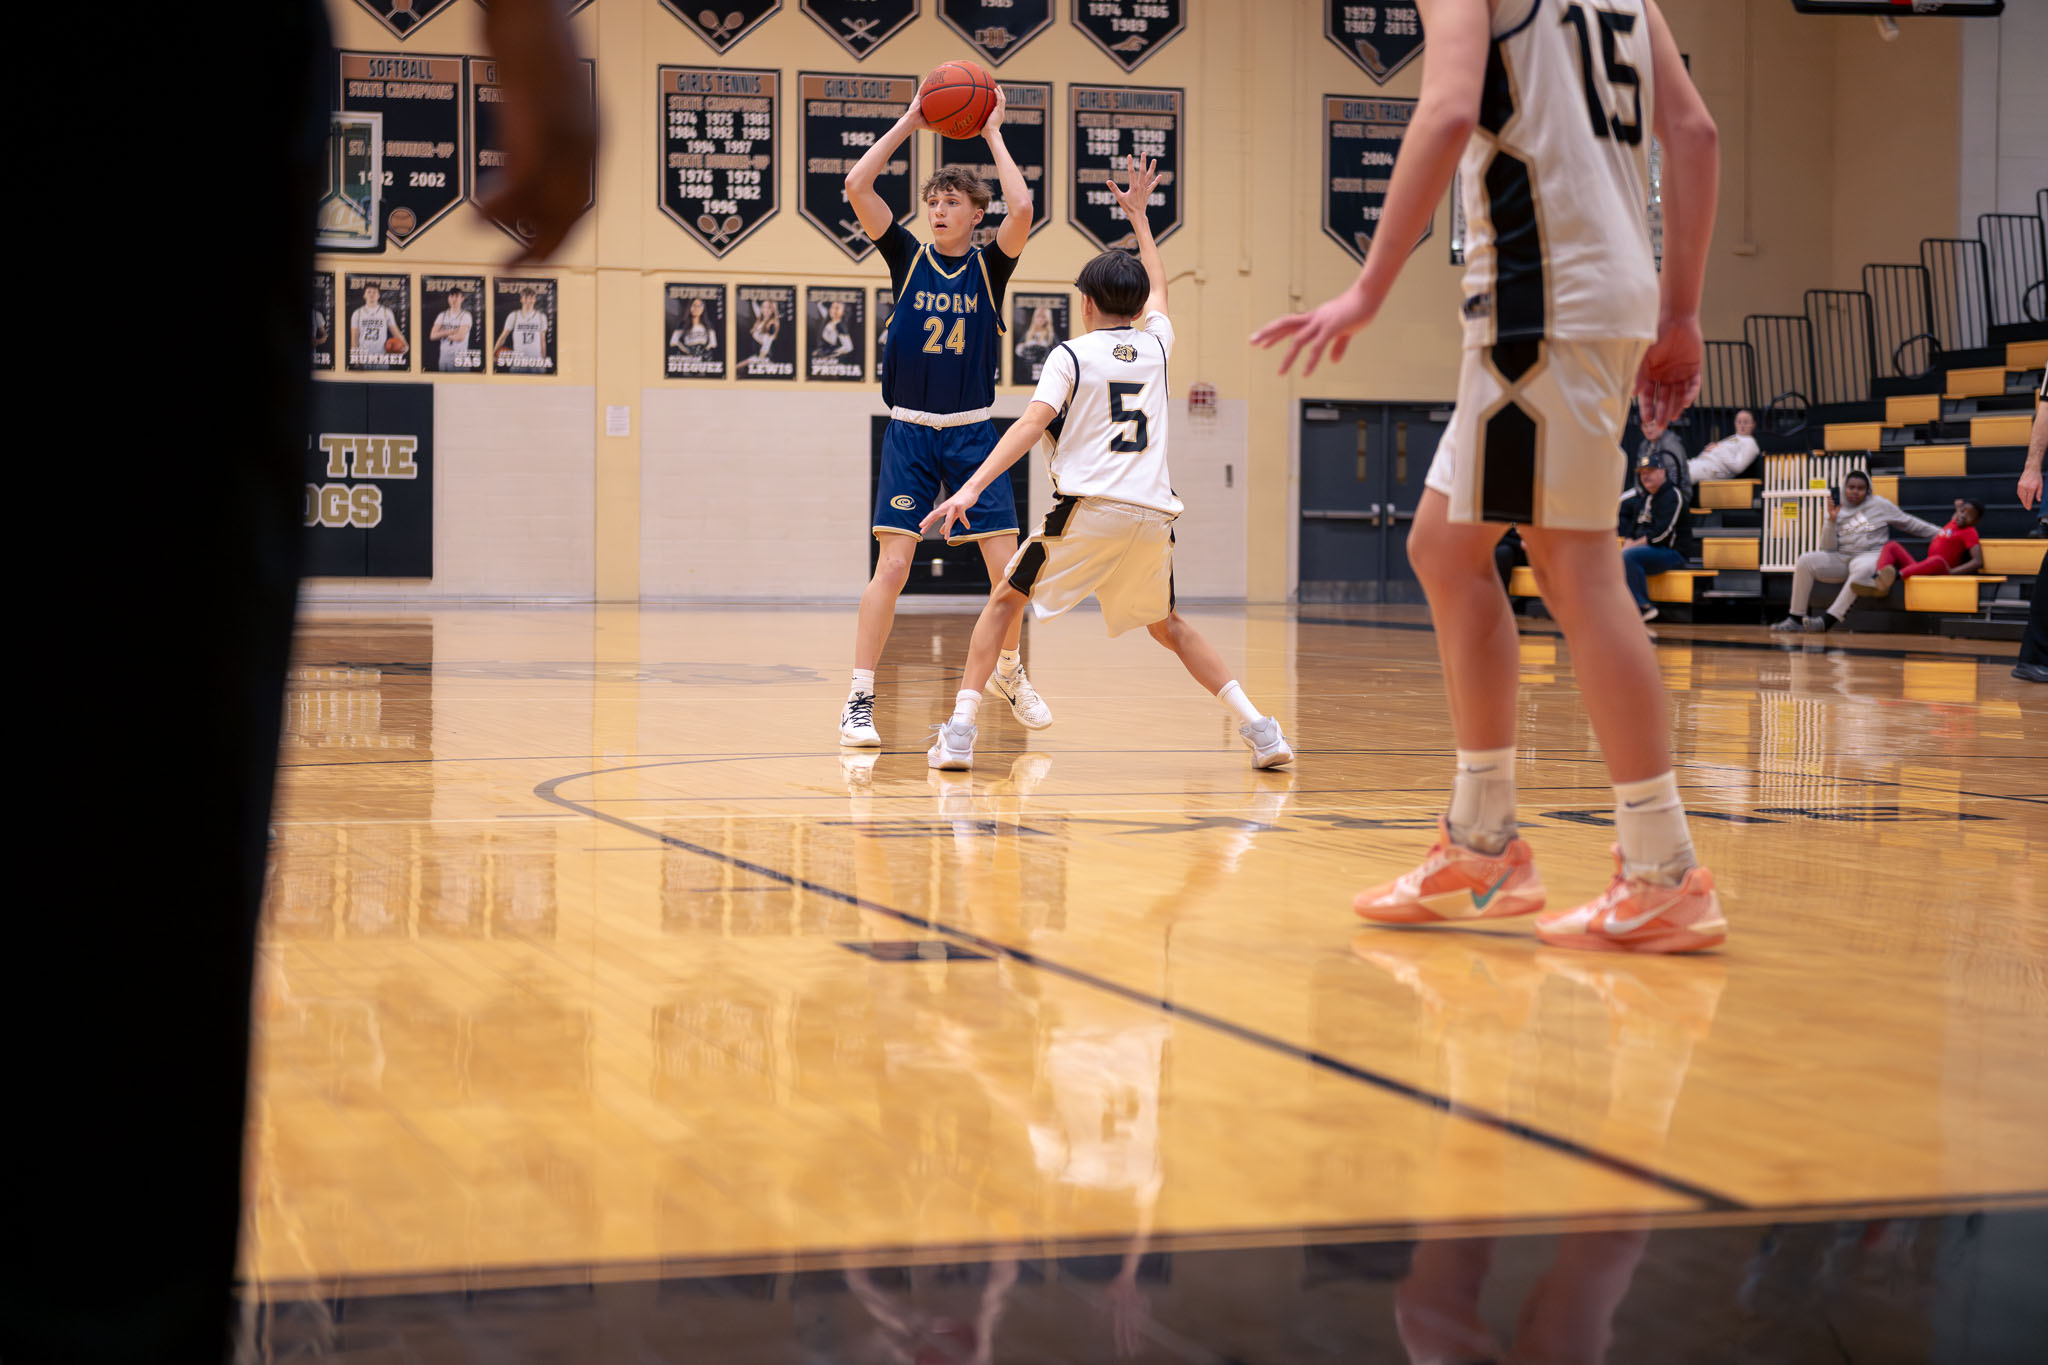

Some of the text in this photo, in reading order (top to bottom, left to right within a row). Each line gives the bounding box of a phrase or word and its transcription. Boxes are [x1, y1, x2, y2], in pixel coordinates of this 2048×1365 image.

[368, 59, 433, 80] SOFTBALL
[1561, 5, 1642, 146] 15
[348, 82, 385, 98] STATE
[677, 74, 762, 94] GIRLS TENNIS
[824, 81, 892, 99] GIRLS GOLF
[1078, 91, 1112, 109] GIRLS
[1343, 103, 1376, 120] GIRLS
[409, 172, 446, 188] 2002
[678, 170, 761, 185] 1976 1979
[913, 291, 979, 314] STORM
[922, 317, 966, 355] 24
[454, 358, 482, 369] SAS
[748, 363, 794, 376] LEWIS
[1107, 381, 1152, 455] 5
[319, 433, 418, 480] THE
